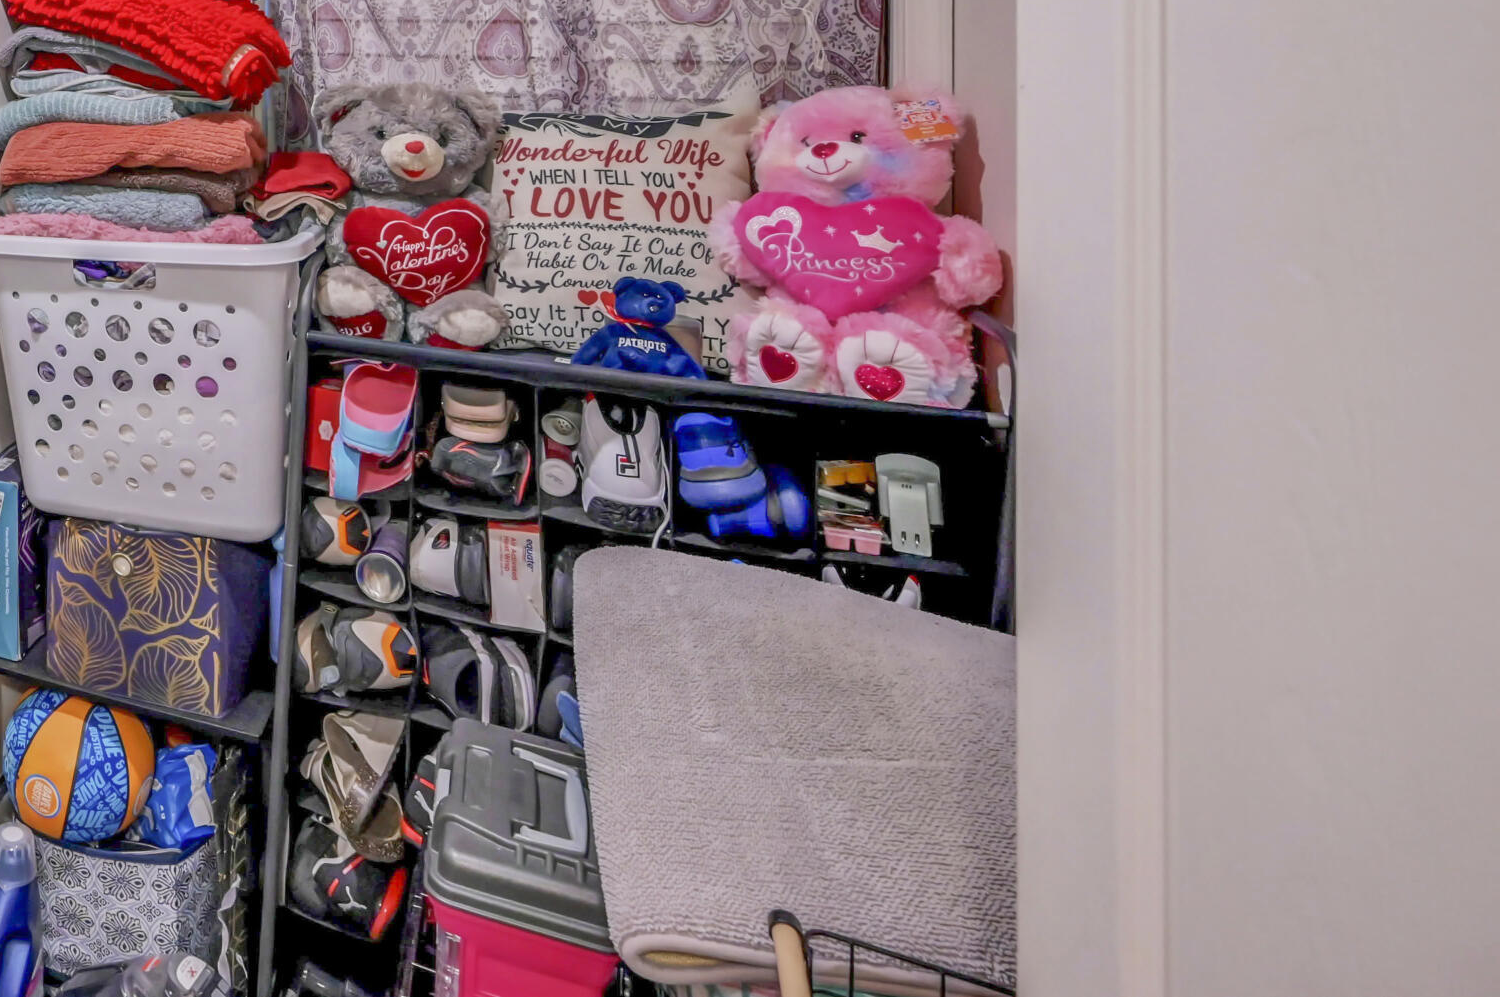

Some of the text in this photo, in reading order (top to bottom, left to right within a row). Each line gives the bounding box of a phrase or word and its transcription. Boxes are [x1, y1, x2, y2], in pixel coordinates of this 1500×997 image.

[495, 138, 725, 170] Wonderful Wife
[529, 169, 676, 189] WHEN I TELL YOU
[502, 187, 713, 224] I LOVE YOU
[357, 226, 470, 276] Valentine's
[393, 240, 427, 254] Happy
[507, 232, 715, 265] I Don't Say It Out Of
[761, 233, 906, 282] Princess
[526, 252, 697, 278] Habit Or To Make
[388, 271, 456, 294] Day
[503, 304, 605, 324] Say It To
[541, 340, 583, 350] EVE
[618, 337, 667, 353] PATRIOTS
[511, 549, 519, 581] Activated
[526, 539, 534, 572] equate
[17, 718, 29, 749] DAVE
[93, 712, 125, 758] DAVE
[73, 769, 106, 807] DAVE
